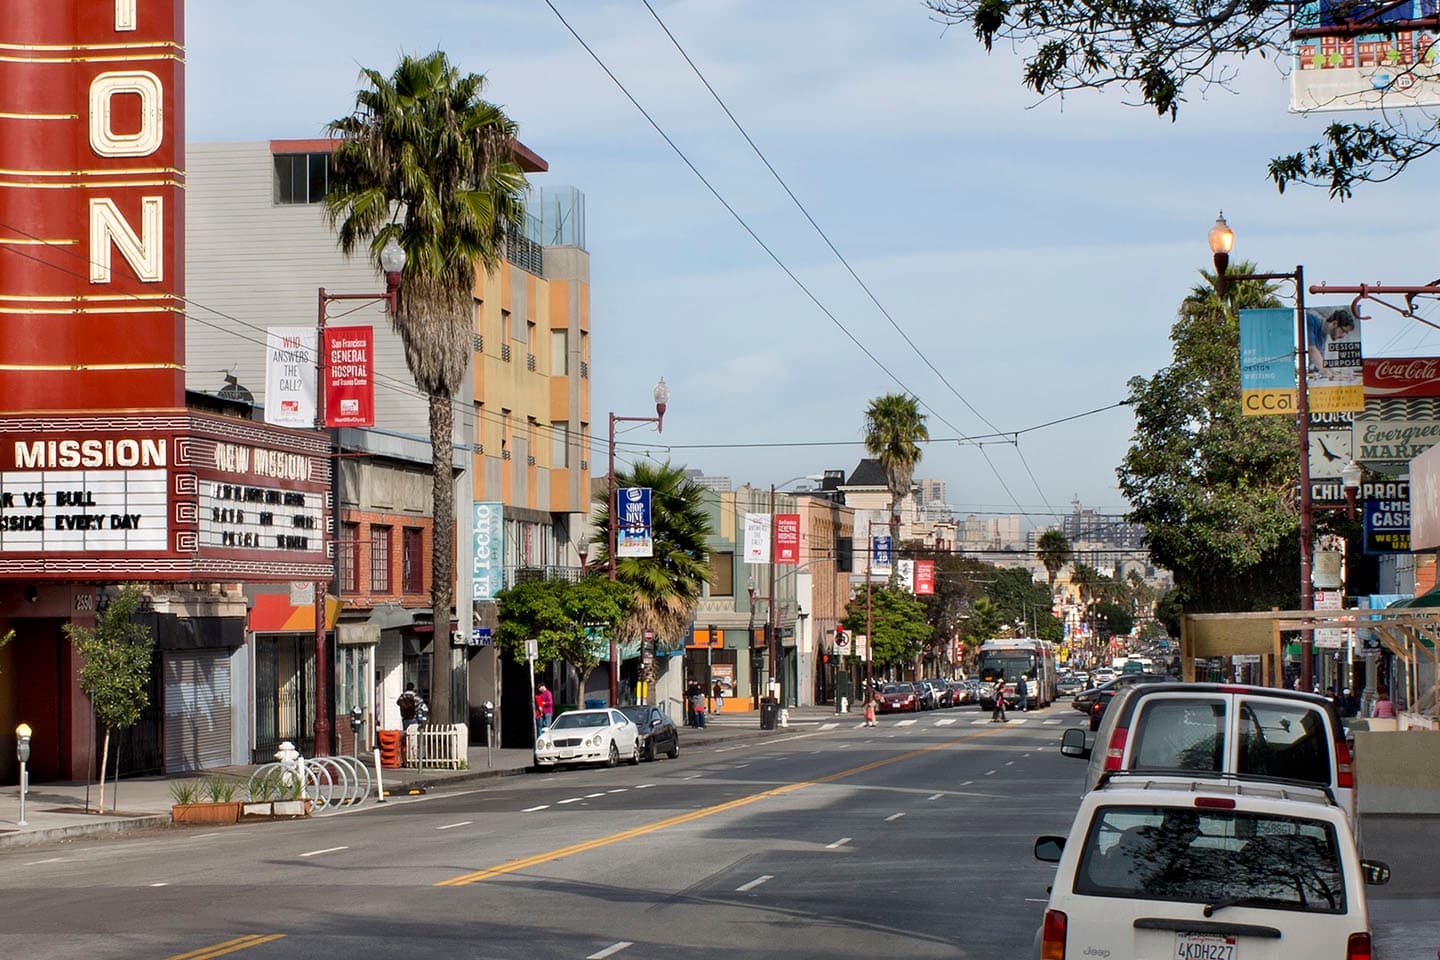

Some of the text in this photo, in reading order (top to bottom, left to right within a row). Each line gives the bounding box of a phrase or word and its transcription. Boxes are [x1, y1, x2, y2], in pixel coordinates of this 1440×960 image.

[282, 336, 301, 349] WHO
[331, 339, 367, 349] San Francisco
[1329, 343, 1360, 351] DESIGN
[273, 350, 310, 363] ANSWERS
[331, 350, 368, 363] GENERAL
[1340, 351, 1361, 359] WITH
[1243, 364, 1271, 372] DESIGN
[1323, 359, 1361, 368] PURPOSE
[1375, 360, 1438, 380] Coca-Cola
[284, 364, 298, 377] THE
[331, 365, 367, 378] HOSPITAL
[280, 379, 302, 392] CALL?
[1363, 425, 1440, 446] Evergree
[15, 439, 167, 468] MISSION
[1360, 443, 1435, 459] MARK
[214, 442, 309, 481] NEW MISSION
[24, 491, 46, 508] VS
[56, 490, 97, 507] BULL
[55, 514, 105, 531] EVERY
[110, 514, 142, 530] DAY
[472, 505, 490, 598] El Techo
[75, 594, 93, 611] 2550
[1083, 945, 1111, 958] Jeep
[1178, 942, 1233, 960] 4KDH227
